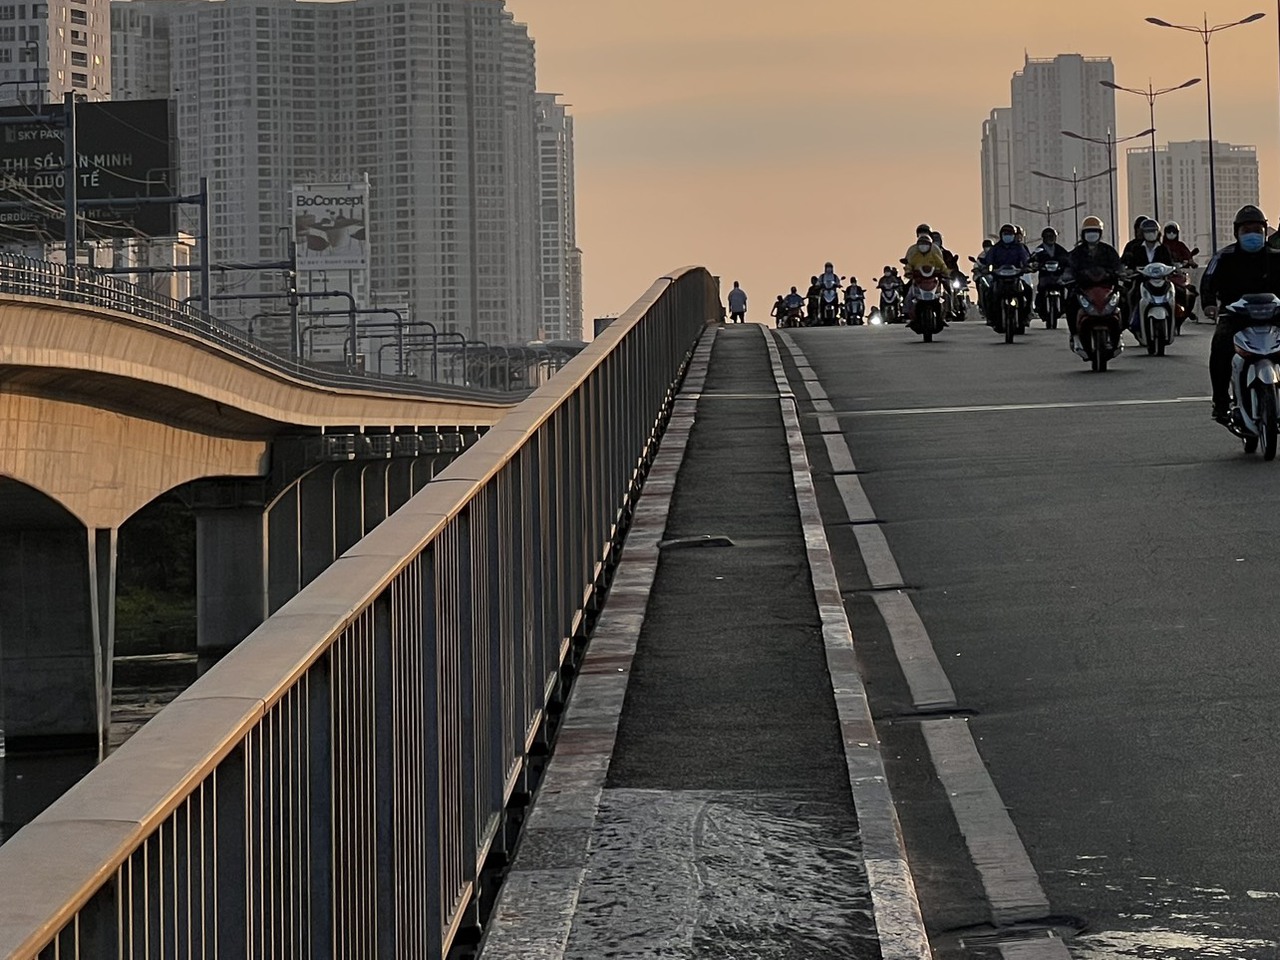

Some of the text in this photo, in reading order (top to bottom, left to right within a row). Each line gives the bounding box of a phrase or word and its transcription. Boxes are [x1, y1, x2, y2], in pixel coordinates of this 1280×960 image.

[18, 131, 37, 141] SKY
[94, 153, 133, 167] MINH
[80, 169, 99, 188] TẾ
[296, 195, 364, 208] BoConcept
